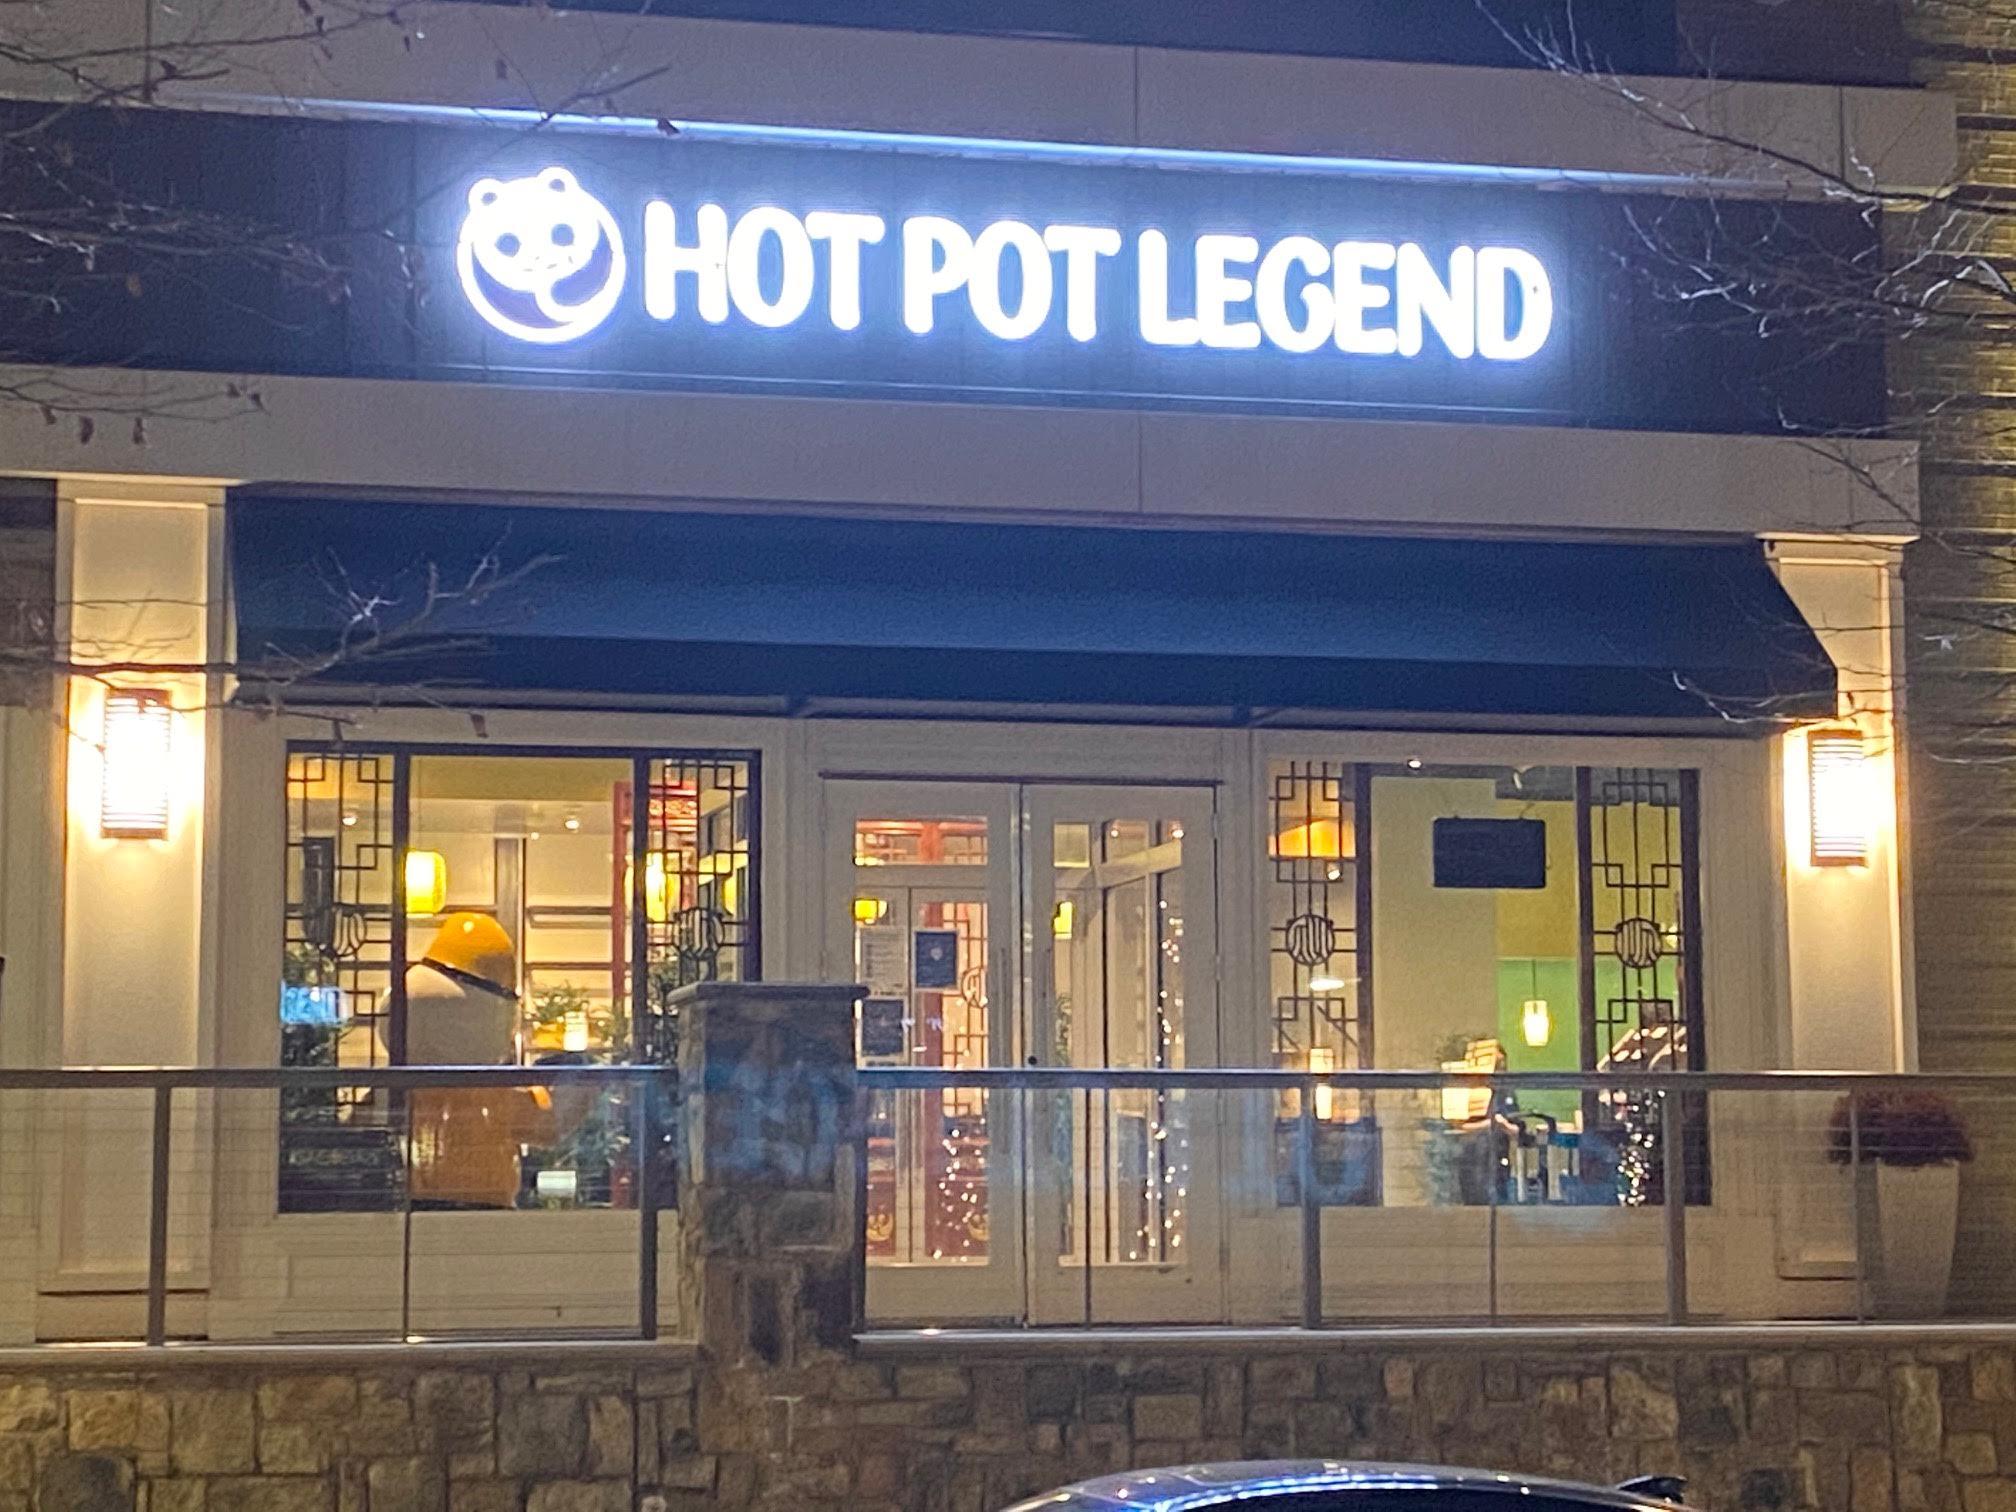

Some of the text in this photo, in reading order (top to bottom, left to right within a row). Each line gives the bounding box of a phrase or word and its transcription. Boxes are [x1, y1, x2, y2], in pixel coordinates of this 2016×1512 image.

[644, 200, 1554, 360] HOT POT LEGEND
